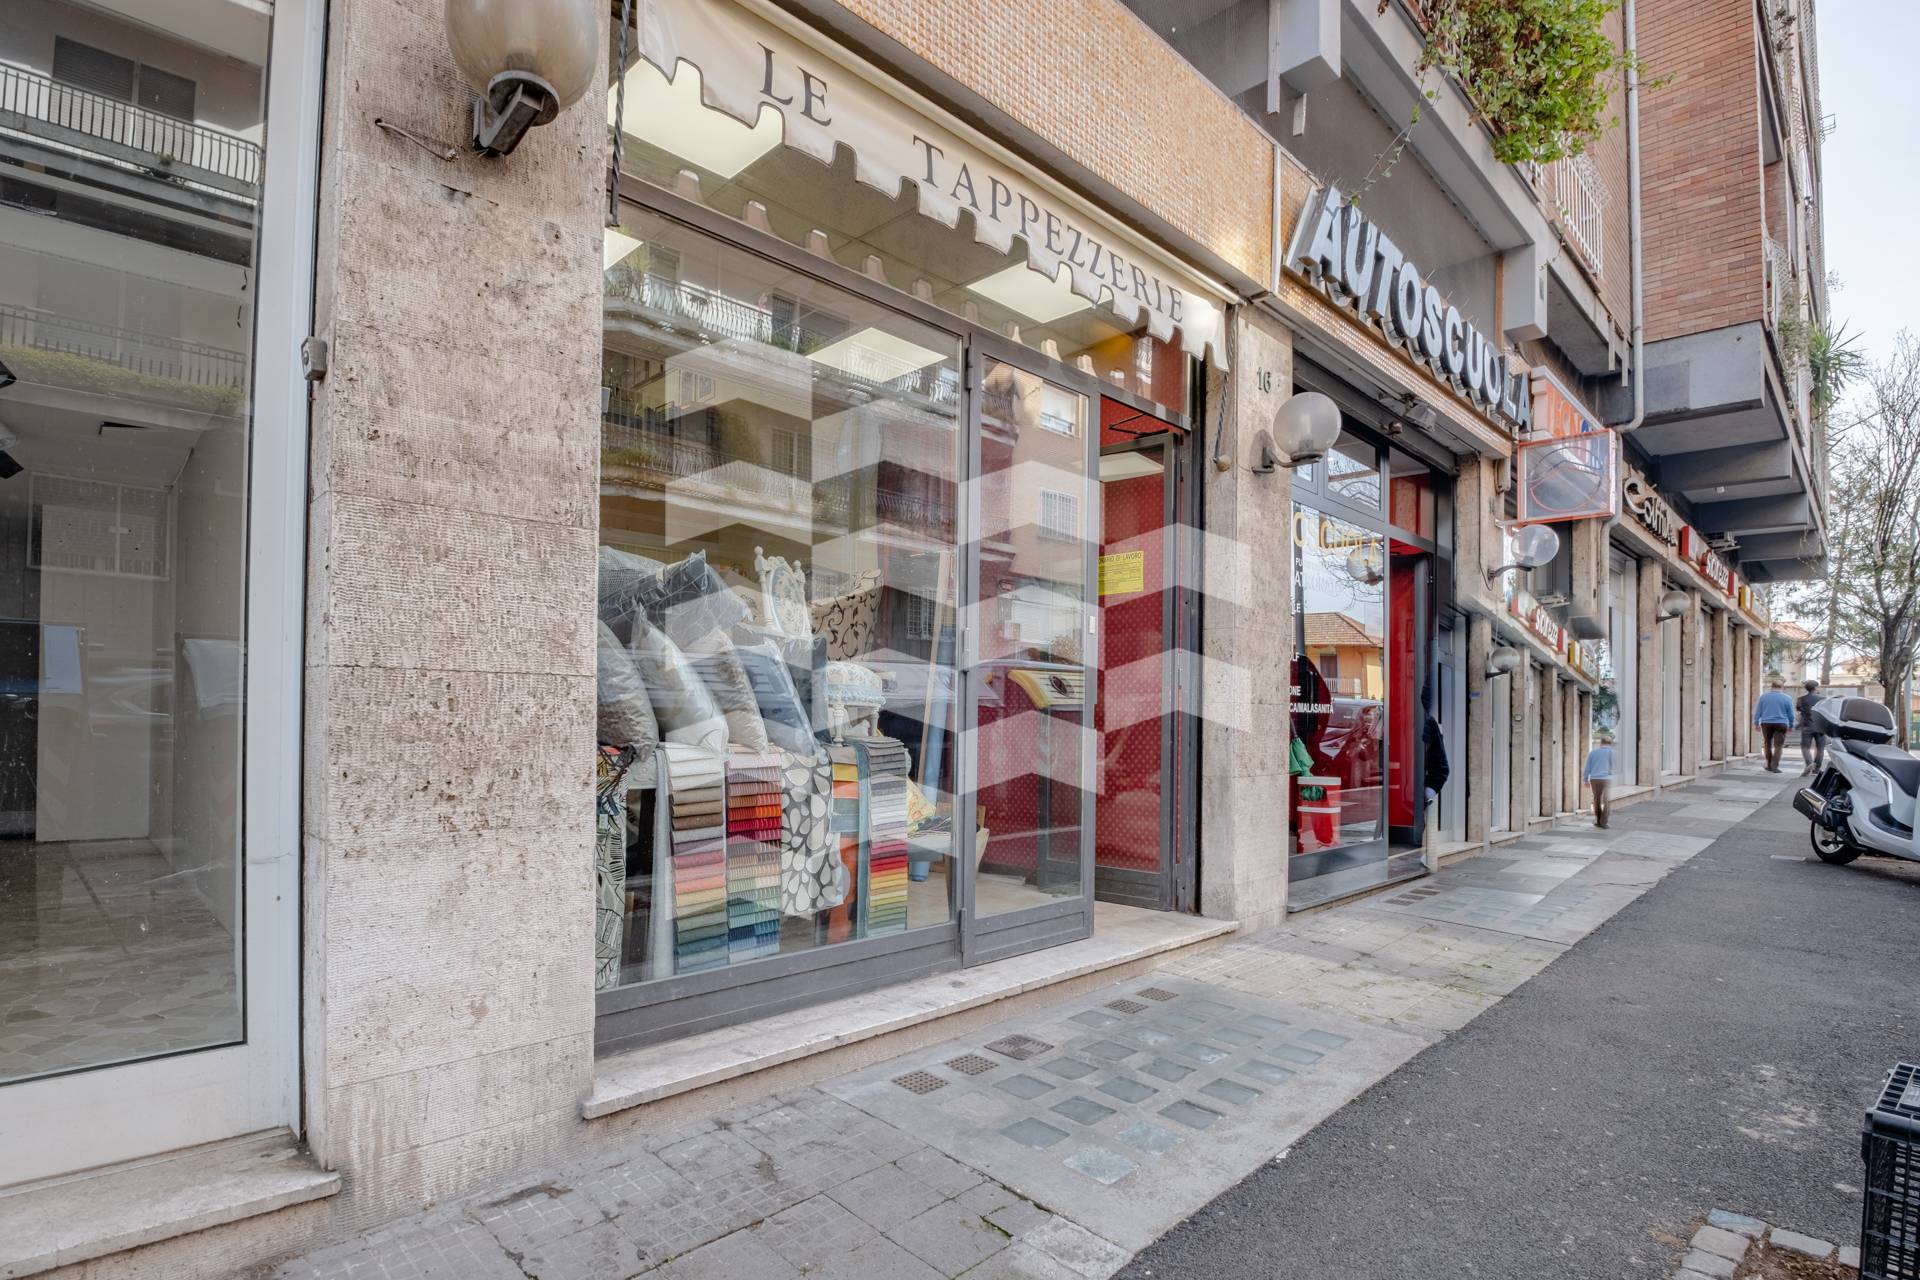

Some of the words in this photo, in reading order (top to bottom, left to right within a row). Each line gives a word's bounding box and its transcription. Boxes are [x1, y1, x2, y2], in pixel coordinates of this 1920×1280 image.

[757, 42, 832, 127] LE
[912, 134, 1184, 324] TAPPEZZERIE
[1283, 183, 1533, 433] AUTOSCUOLA
[1256, 366, 1271, 394] 16
